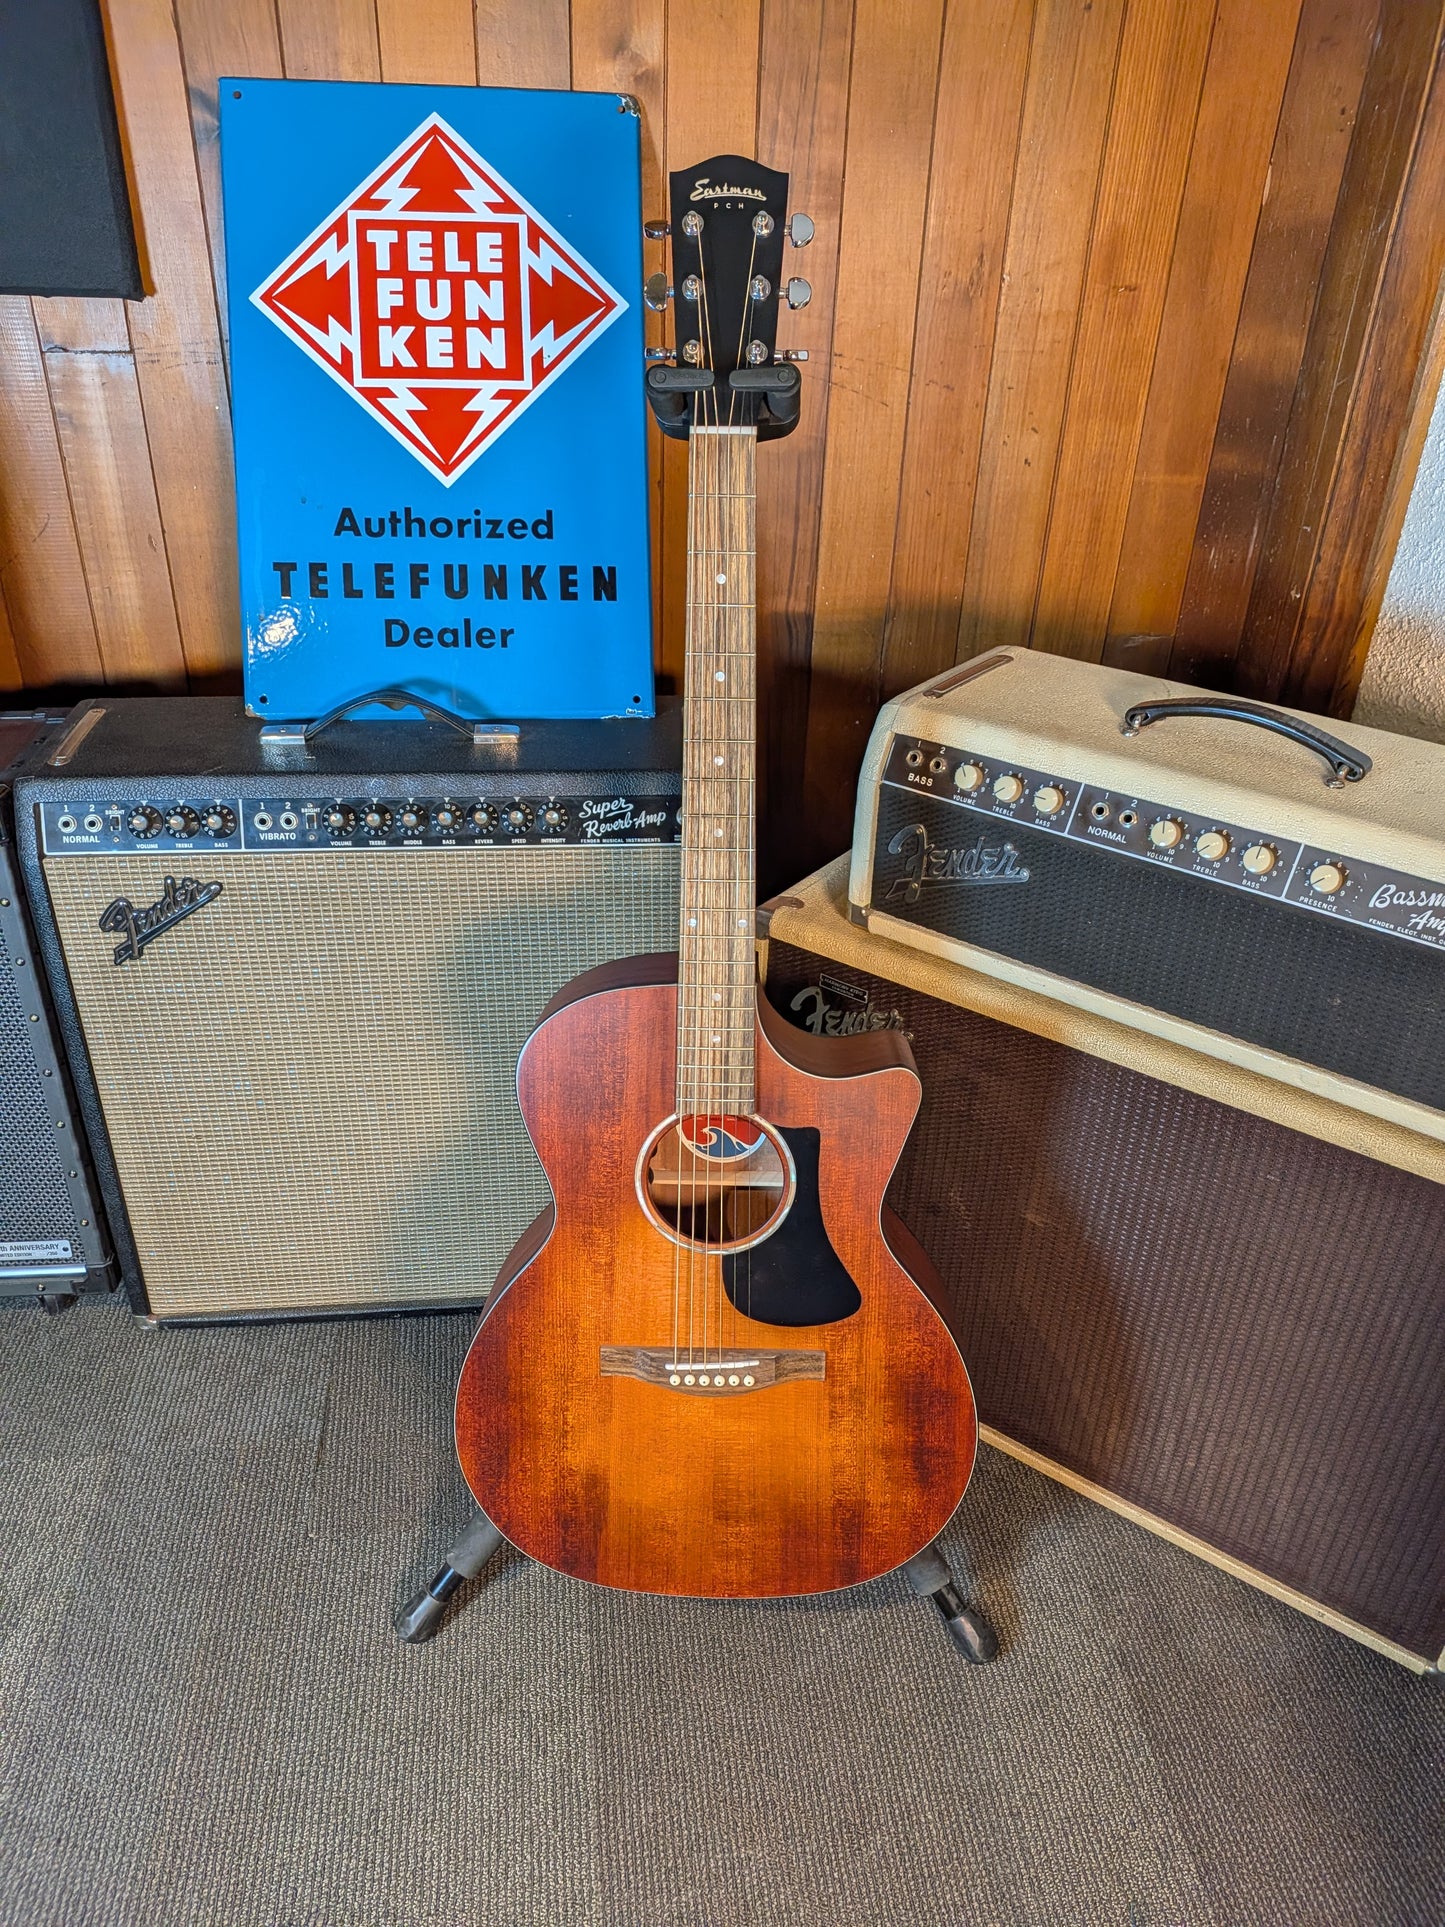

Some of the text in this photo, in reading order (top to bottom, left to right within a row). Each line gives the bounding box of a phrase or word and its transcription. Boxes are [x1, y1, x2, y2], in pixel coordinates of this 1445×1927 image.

[690, 178, 767, 201] Eastman
[366, 230, 504, 274] TELE
[378, 279, 504, 322] FUN
[379, 325, 507, 369] KEN
[334, 507, 554, 540] Authorized
[272, 562, 618, 601] TELEFUNKEN
[384, 618, 515, 649] Dealer
[917, 740, 946, 755] 1 2
[907, 772, 934, 787] BASS
[260, 801, 291, 810] 1 2
[953, 794, 976, 805] VOLUME
[1104, 792, 1138, 808] 1 2
[64, 804, 95, 813] 1 2
[578, 797, 634, 820] Super
[992, 805, 1015, 817] TREBLE
[582, 810, 667, 838] Reverb-Amp
[1035, 818, 1051, 828] BASS
[63, 835, 100, 843] NORMAL
[259, 832, 296, 840] VIBRATO
[1087, 825, 1127, 844] NORMAL
[884, 823, 1030, 900] Fender
[1146, 850, 1174, 863] VOLUME
[1192, 864, 1218, 877] TREBLE
[1241, 879, 1261, 889] BASS
[1299, 895, 1338, 912] PRESENCE
[99, 875, 223, 966] Fender
[1368, 918, 1395, 930] FENDER
[1396, 926, 1418, 937] ELECT.
[1420, 933, 1437, 943] INST.
[790, 986, 913, 1040] Fender
[10, 1243, 59, 1251] ANNIVERSARY
